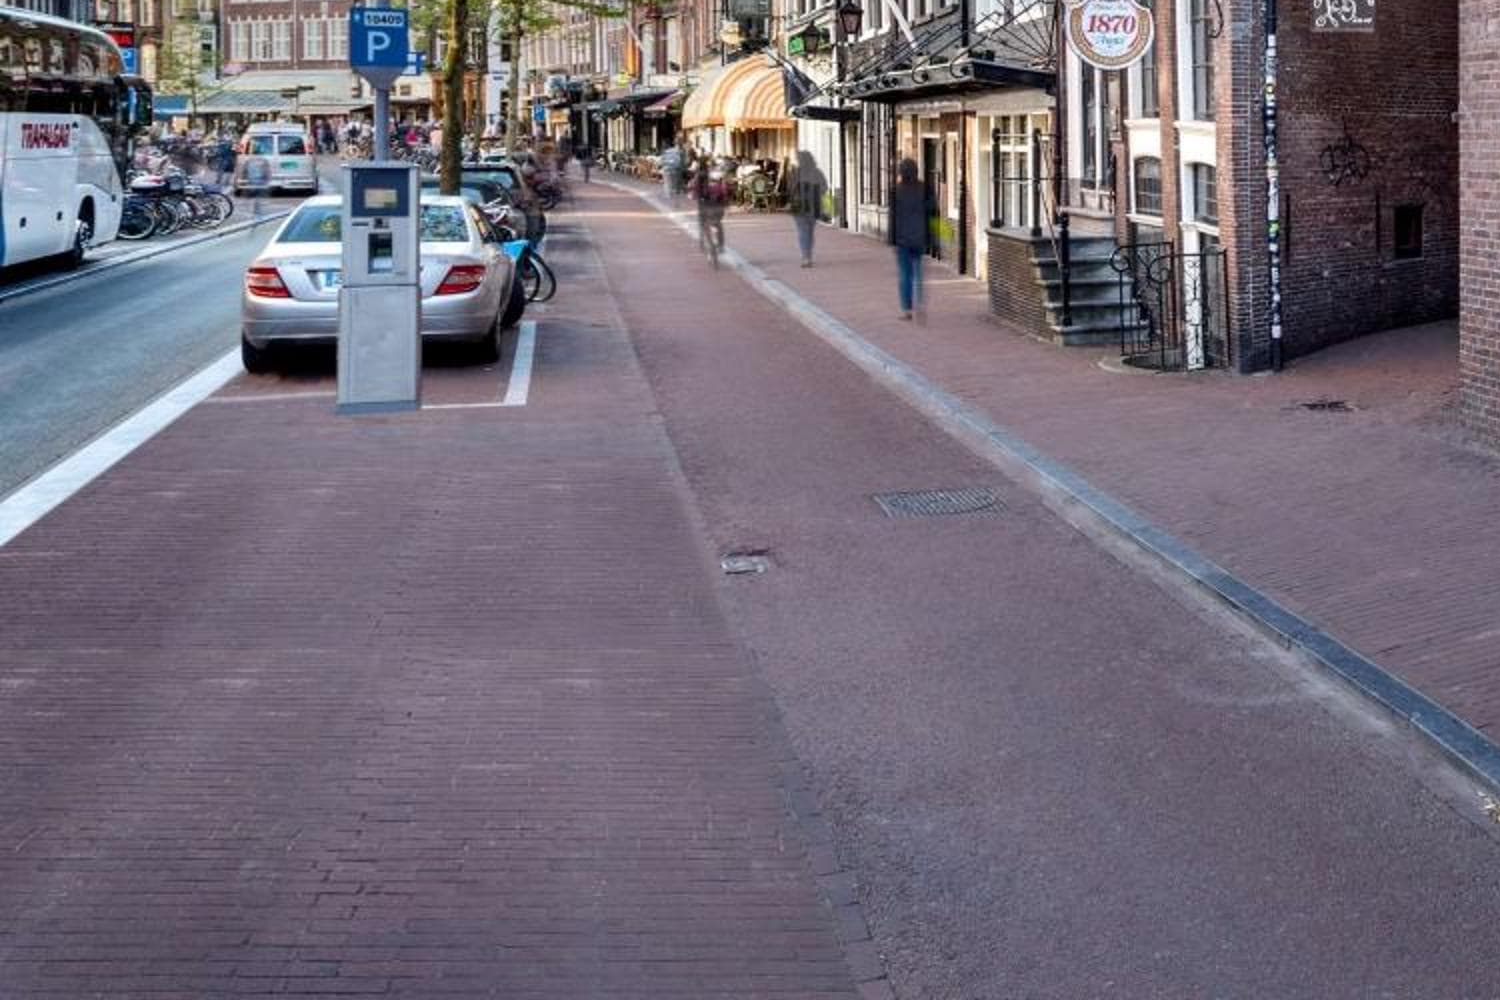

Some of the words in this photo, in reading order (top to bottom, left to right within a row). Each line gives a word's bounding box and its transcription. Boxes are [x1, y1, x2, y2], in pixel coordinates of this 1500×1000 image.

[1087, 14, 1136, 34] 1870
[367, 31, 391, 62] P
[21, 123, 71, 149] TRAFALGAR
